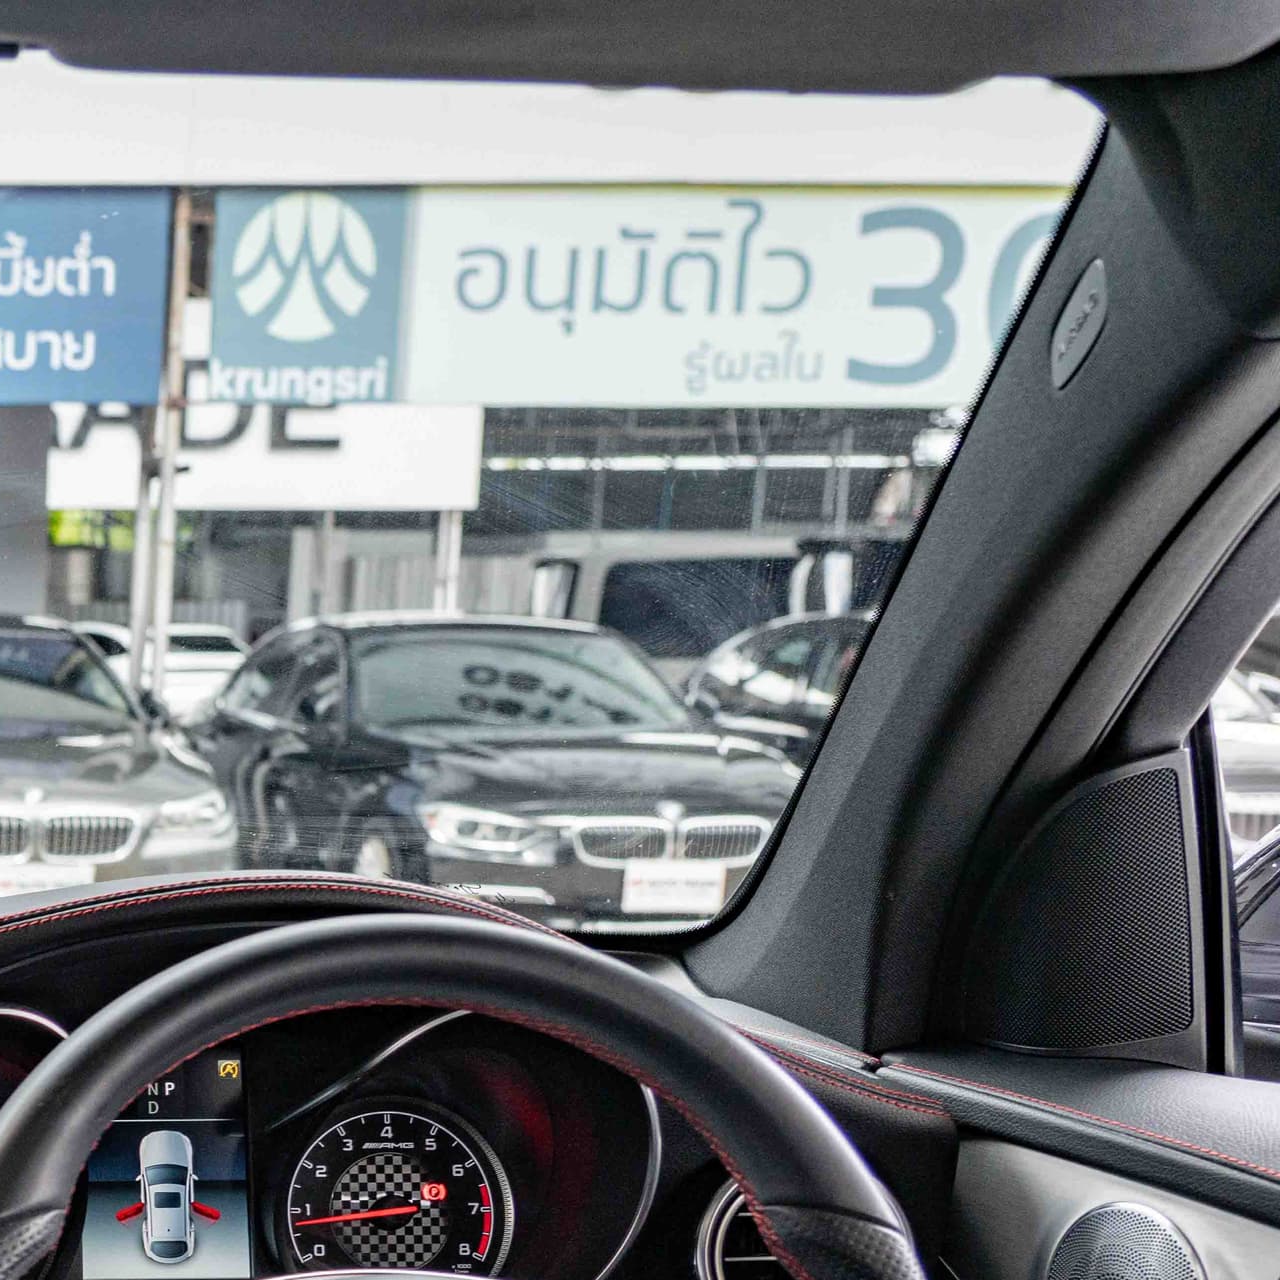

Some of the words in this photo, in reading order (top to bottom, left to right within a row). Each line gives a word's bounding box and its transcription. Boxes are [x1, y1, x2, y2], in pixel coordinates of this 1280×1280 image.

[454, 199, 814, 334] อนุมัติไว
[209, 355, 389, 406] krungsri
[147, 1083, 159, 1096] N
[164, 1082, 176, 1096] P
[148, 1101, 160, 1115] D
[380, 1126, 393, 1138] 4
[342, 1139, 353, 1151] 3
[425, 1138, 437, 1150] 5
[315, 1165, 327, 1178] 2
[452, 1164, 464, 1176] 6
[304, 1203, 311, 1216] 1
[468, 1202, 479, 1215] 7
[314, 1244, 325, 1257] 0
[459, 1243, 471, 1256] 8
